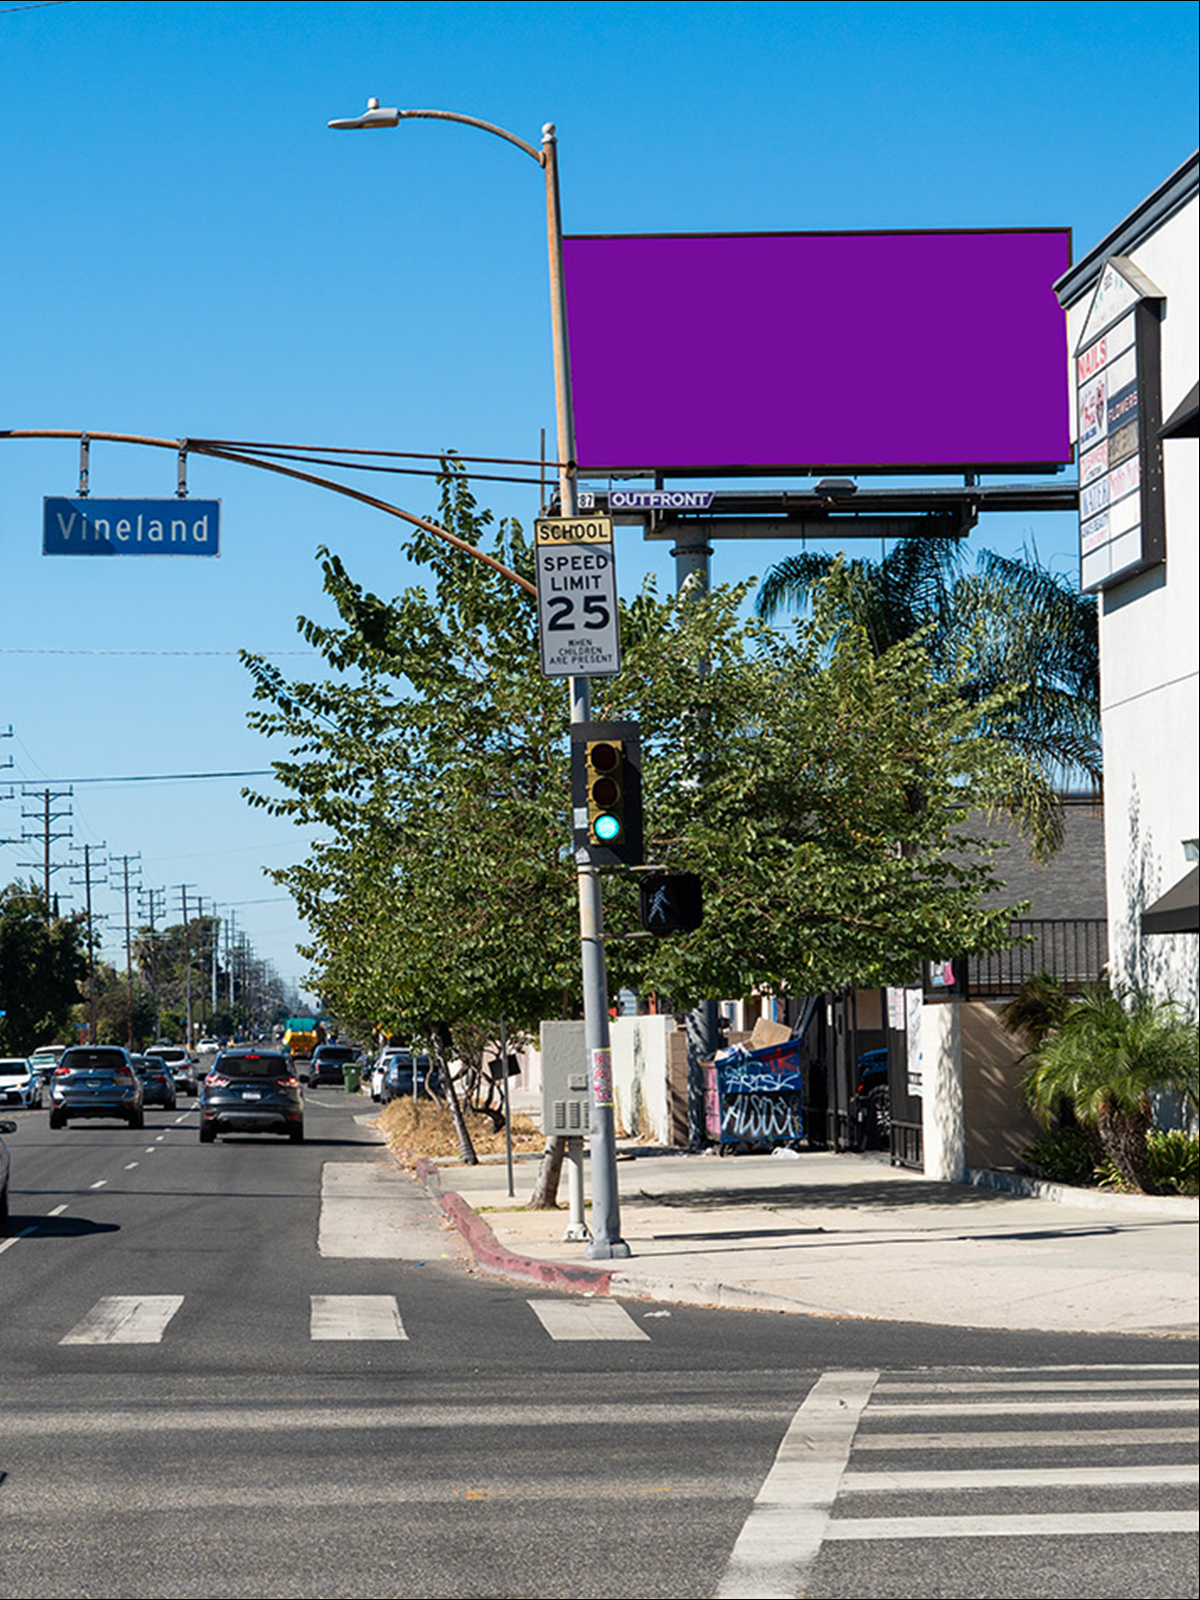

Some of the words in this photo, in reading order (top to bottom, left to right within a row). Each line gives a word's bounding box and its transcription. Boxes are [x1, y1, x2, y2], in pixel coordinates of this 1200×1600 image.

[1077, 338, 1107, 386] NAILS
[1107, 390, 1138, 422] FLOWERS
[612, 493, 709, 506] OUTFRONT
[56, 512, 208, 542] Vineland
[540, 523, 608, 541] SCHOOL
[543, 555, 608, 571] SPEED
[551, 575, 601, 591] LIMIT
[547, 595, 610, 632] 25
[550, 657, 568, 665] ARE
[571, 654, 613, 664] PRESENT
[558, 647, 602, 657] CHILDREN
